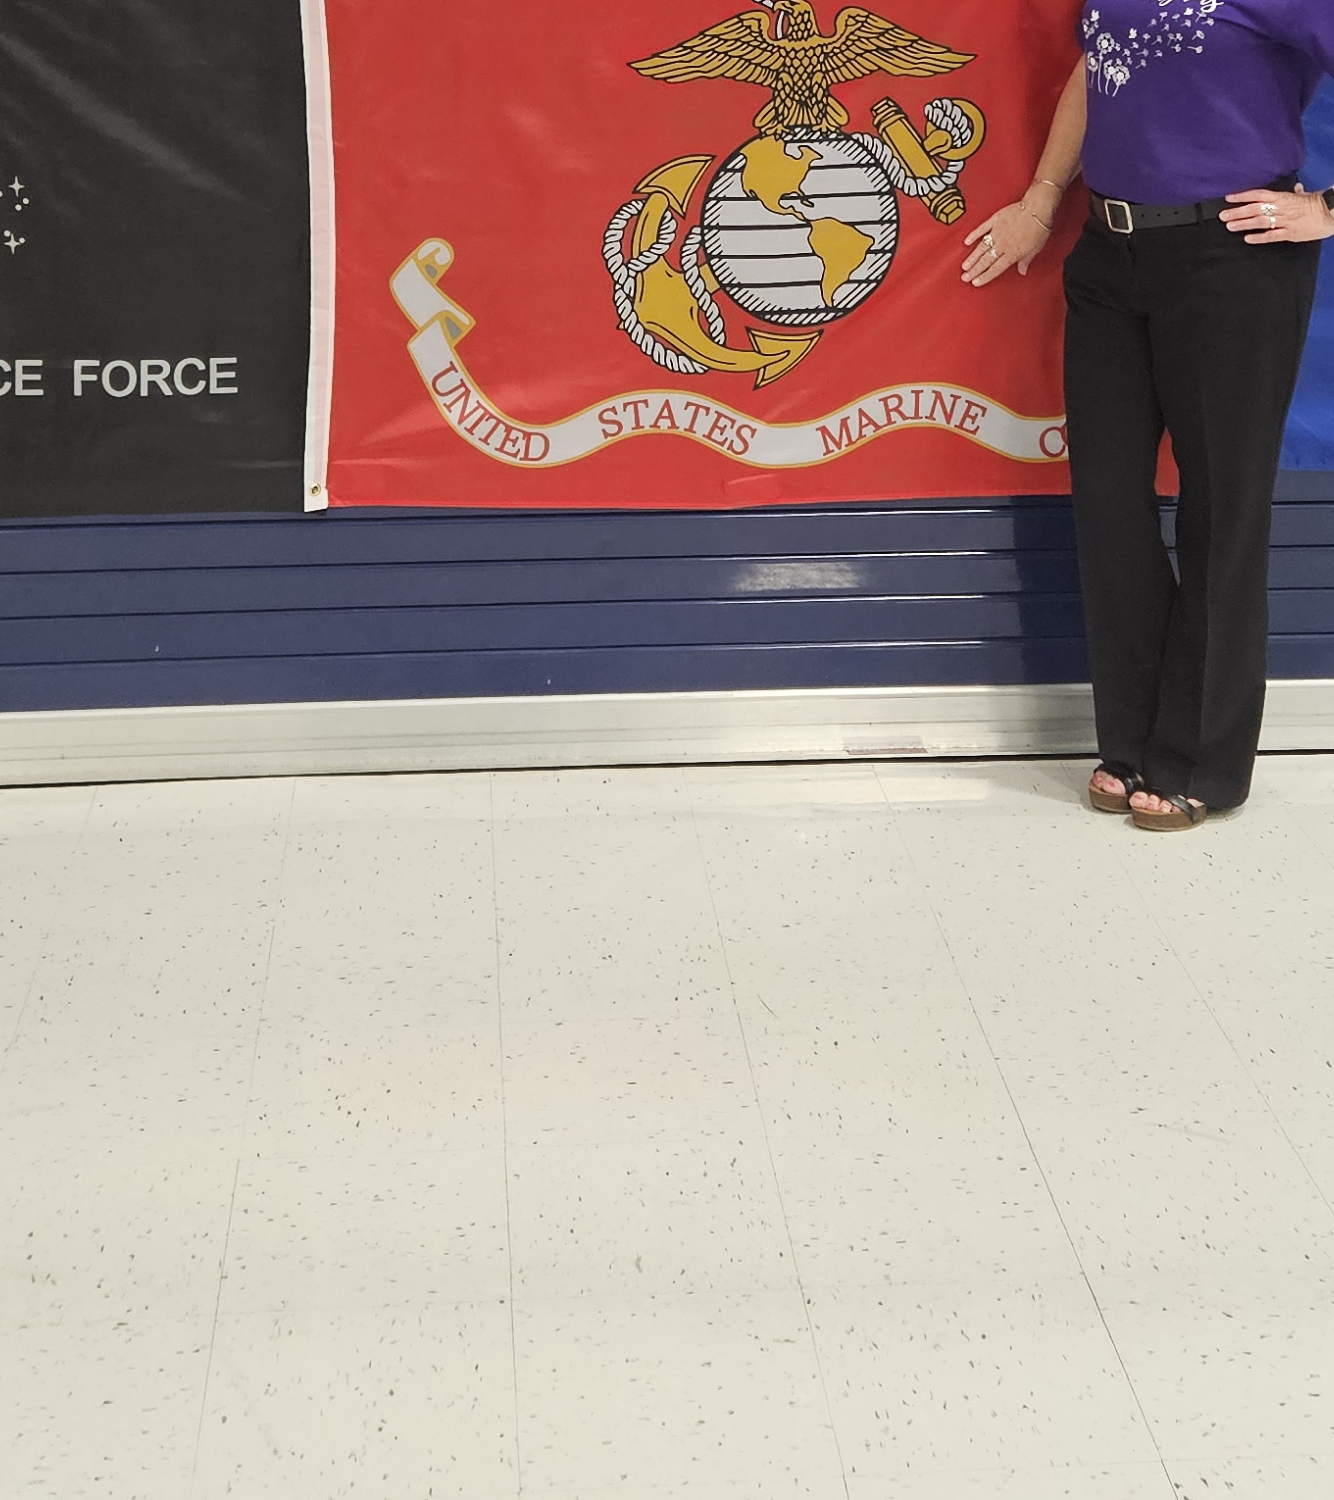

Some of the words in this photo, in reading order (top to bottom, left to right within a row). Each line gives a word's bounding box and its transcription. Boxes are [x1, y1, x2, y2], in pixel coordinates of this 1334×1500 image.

[72, 357, 240, 398] FORCE
[430, 360, 550, 463] UNITED
[598, 397, 757, 456] STATES
[818, 390, 988, 457] MARINE
